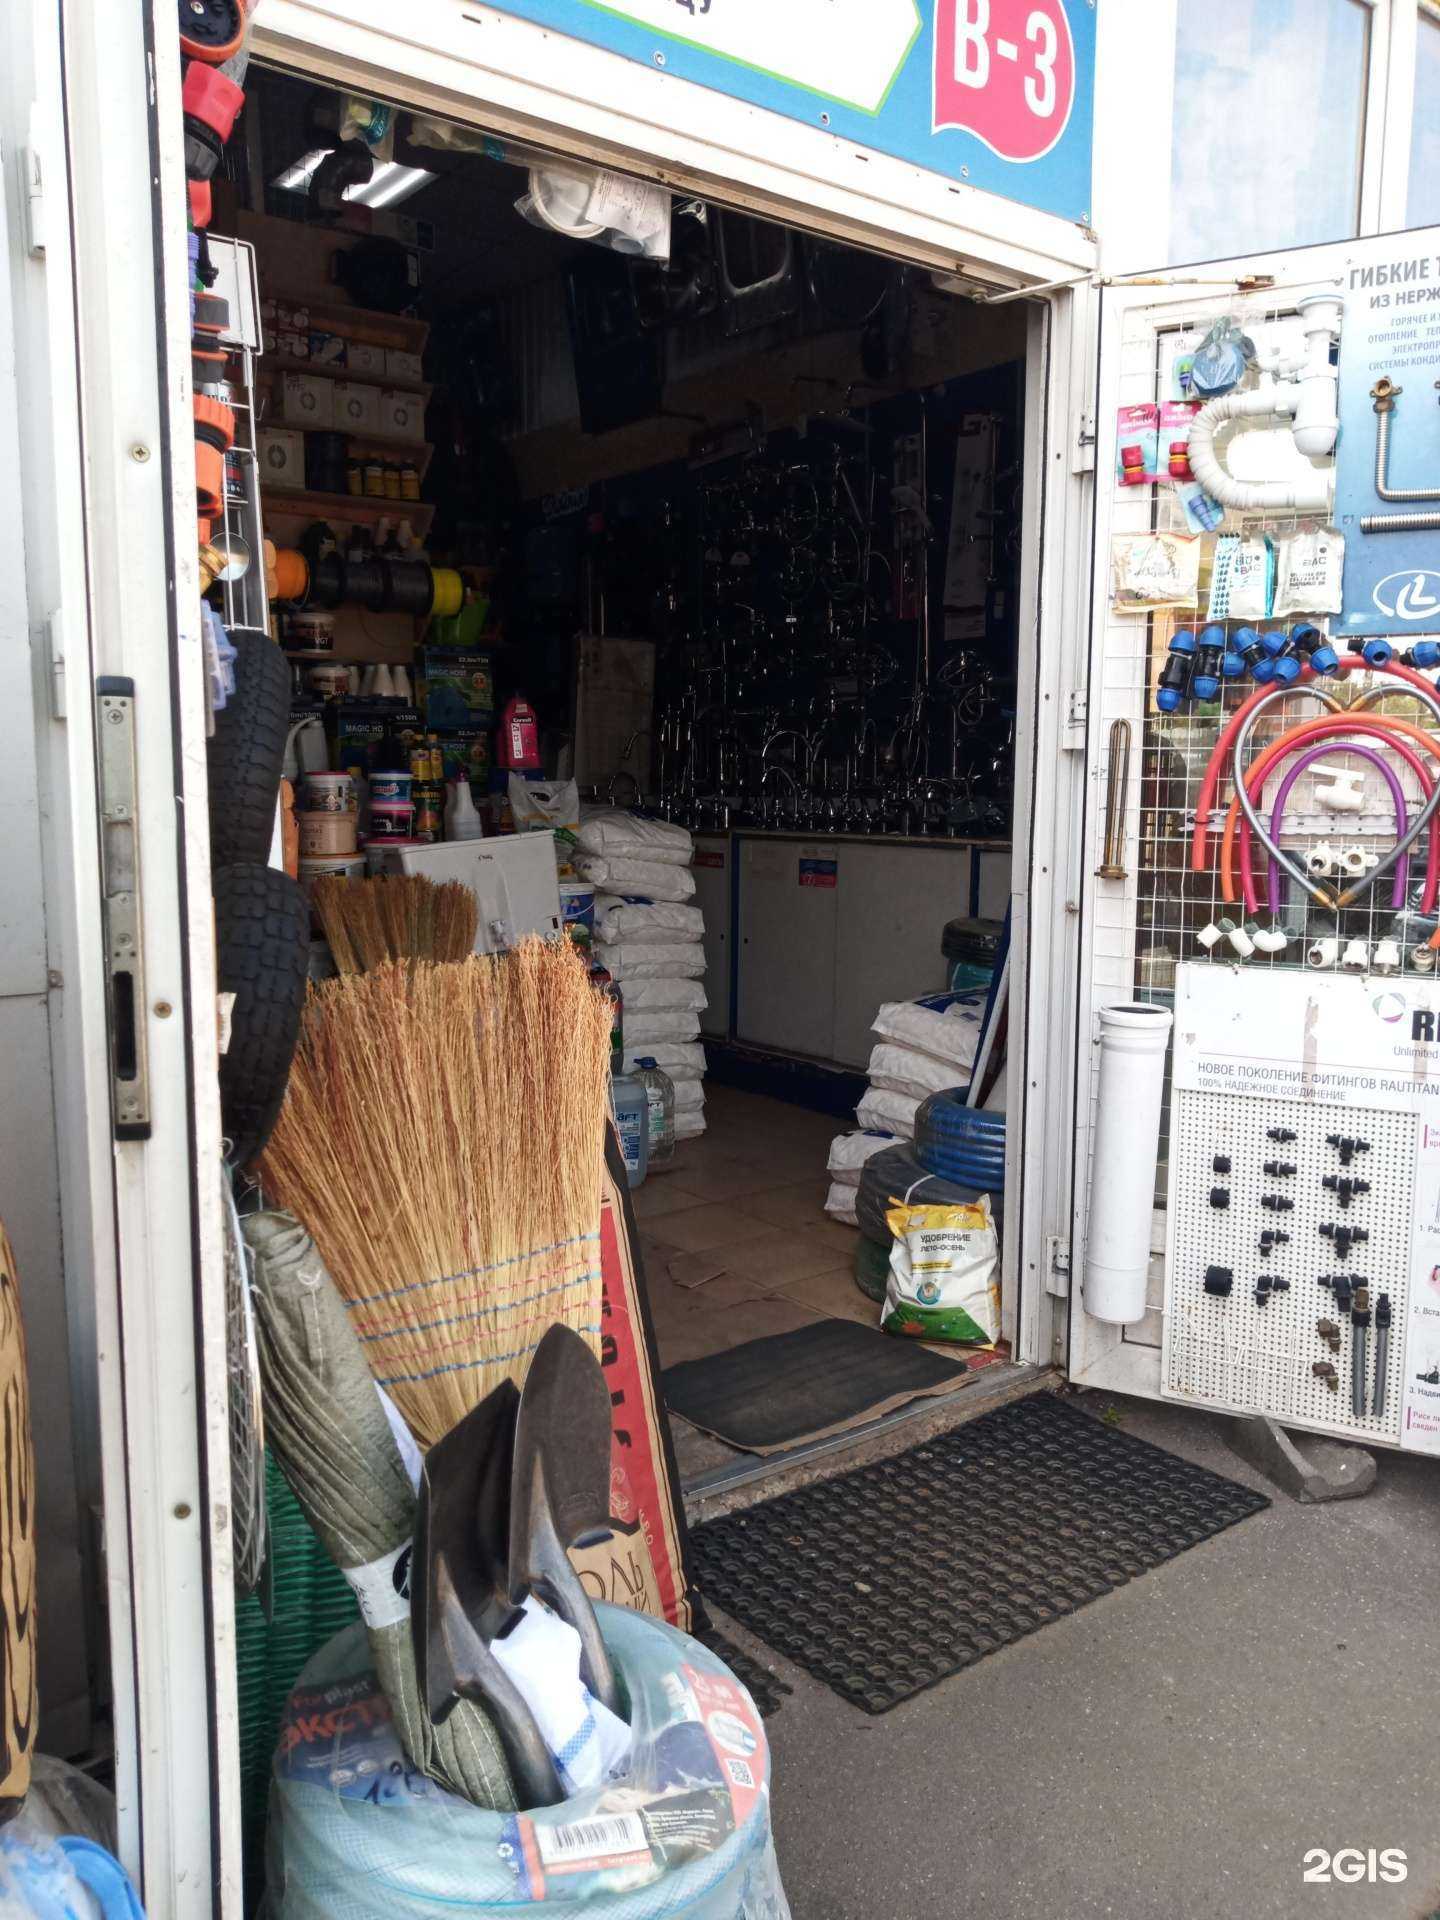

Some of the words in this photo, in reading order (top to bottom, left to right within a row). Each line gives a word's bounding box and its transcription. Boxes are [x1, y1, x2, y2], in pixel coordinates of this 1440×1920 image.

[1350, 257, 1430, 290] ГИБКИЕ
[1369, 294, 1391, 309] ИЗ
[1391, 313, 1428, 327] ГОРЯЧЕЕ
[1368, 328, 1418, 344] ОТОПЛЕНИЕ
[1368, 357, 1409, 371] СИСТЕМЫ
[345, 724, 370, 734] MAGIC
[1393, 1045, 1439, 1060] Unlimited
[1198, 1062, 1235, 1076] НОВОЕ
[1238, 1066, 1308, 1083] ПОКОЛЕНИЕ
[1311, 1074, 1377, 1090] ФИТИНГОВ
[1380, 1079, 1440, 1096] RAUTITAN
[1198, 1077, 1222, 1088] 100%
[1224, 1081, 1279, 1095] НАДЕЖНОЕ
[1281, 1087, 1347, 1101] СОЕДИНЕНИЕ
[920, 1233, 972, 1244] УДОБРЕНИЕ
[920, 1244, 966, 1252] ЛЕТО-ОСЕНЬ
